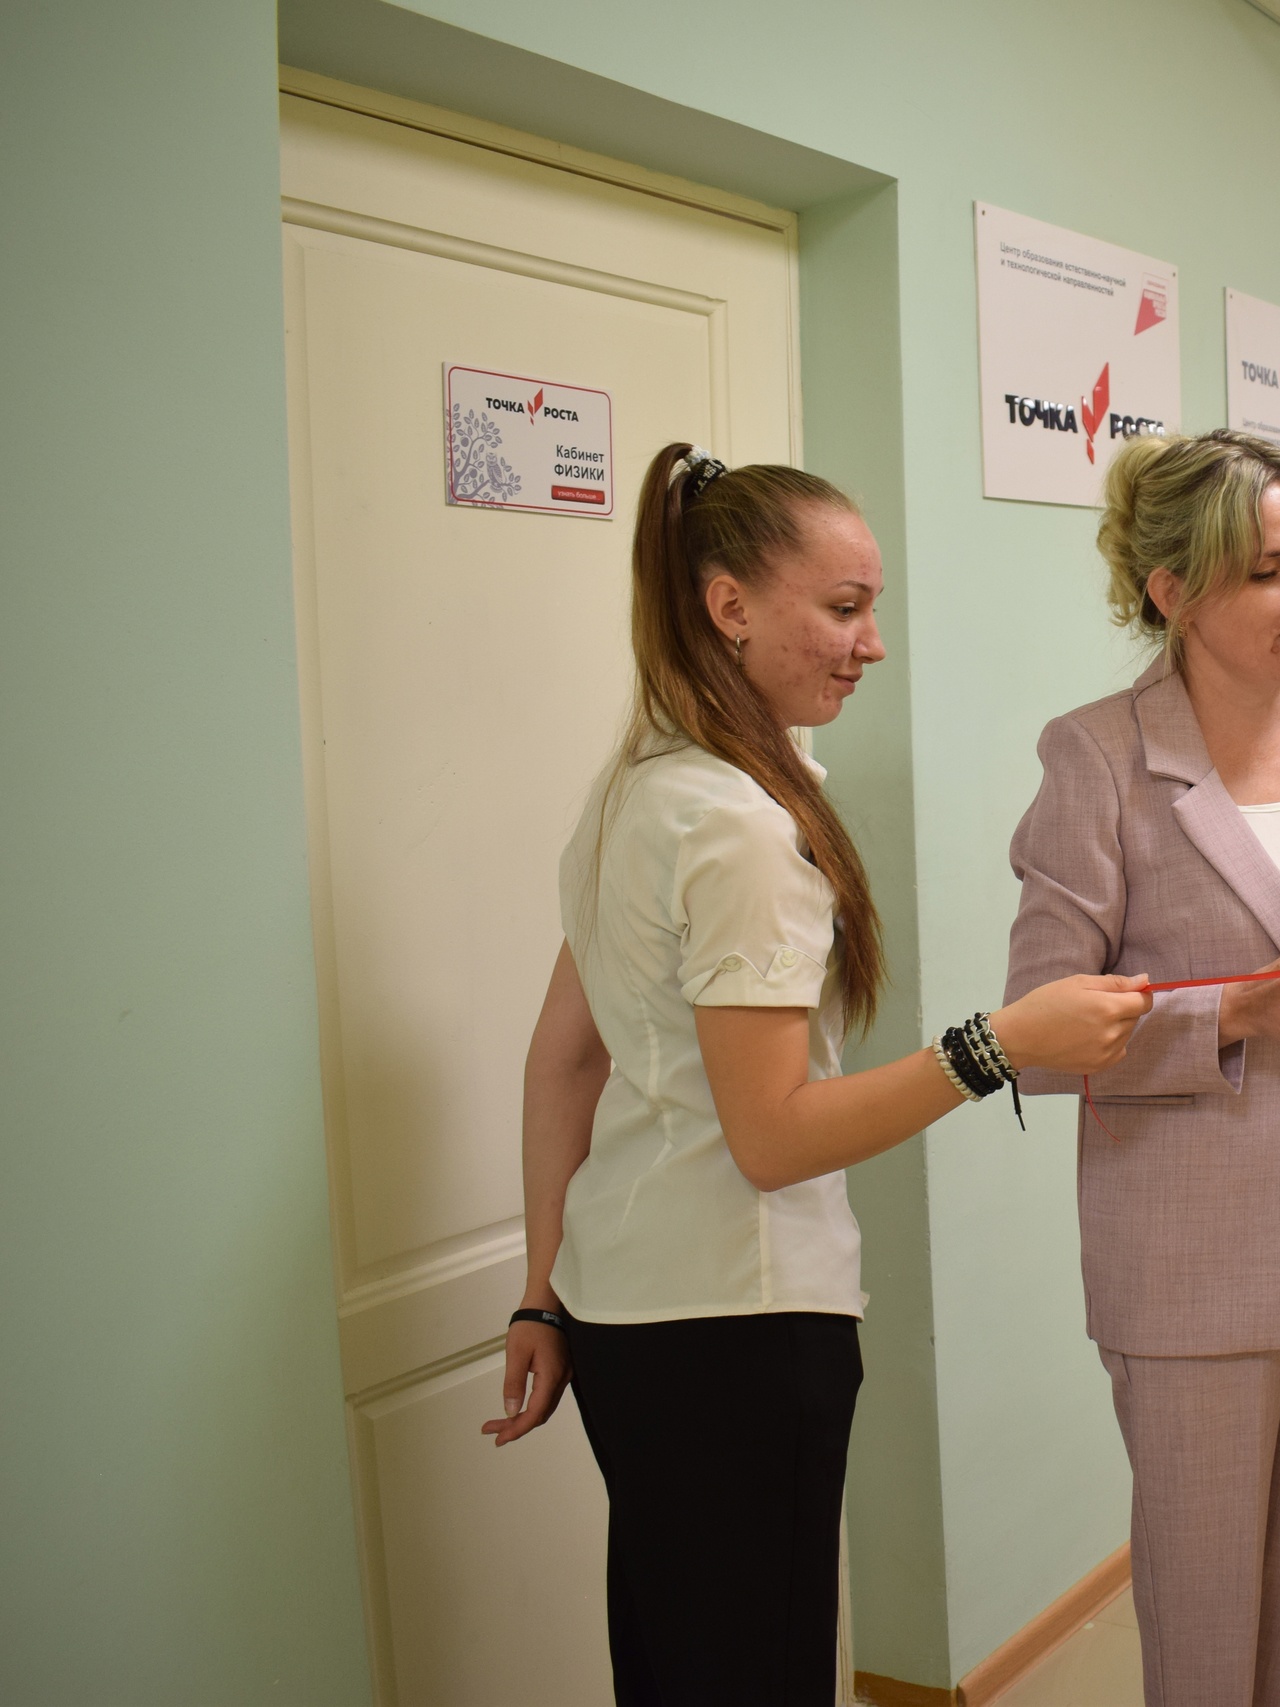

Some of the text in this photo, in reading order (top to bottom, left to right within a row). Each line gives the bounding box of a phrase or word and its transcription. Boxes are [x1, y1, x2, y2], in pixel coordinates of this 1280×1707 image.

[1000, 241, 1021, 257] Центр
[1022, 249, 1063, 268] образования
[1000, 258, 1114, 296] и технологической направленностей
[1241, 360, 1280, 389] ТОЧКА
[485, 397, 579, 422] ТОЧКА РОСТА
[1005, 394, 1078, 433] ТОЧКА
[556, 444, 605, 463] Кабинет
[554, 463, 605, 481] ФИЗИКИ
